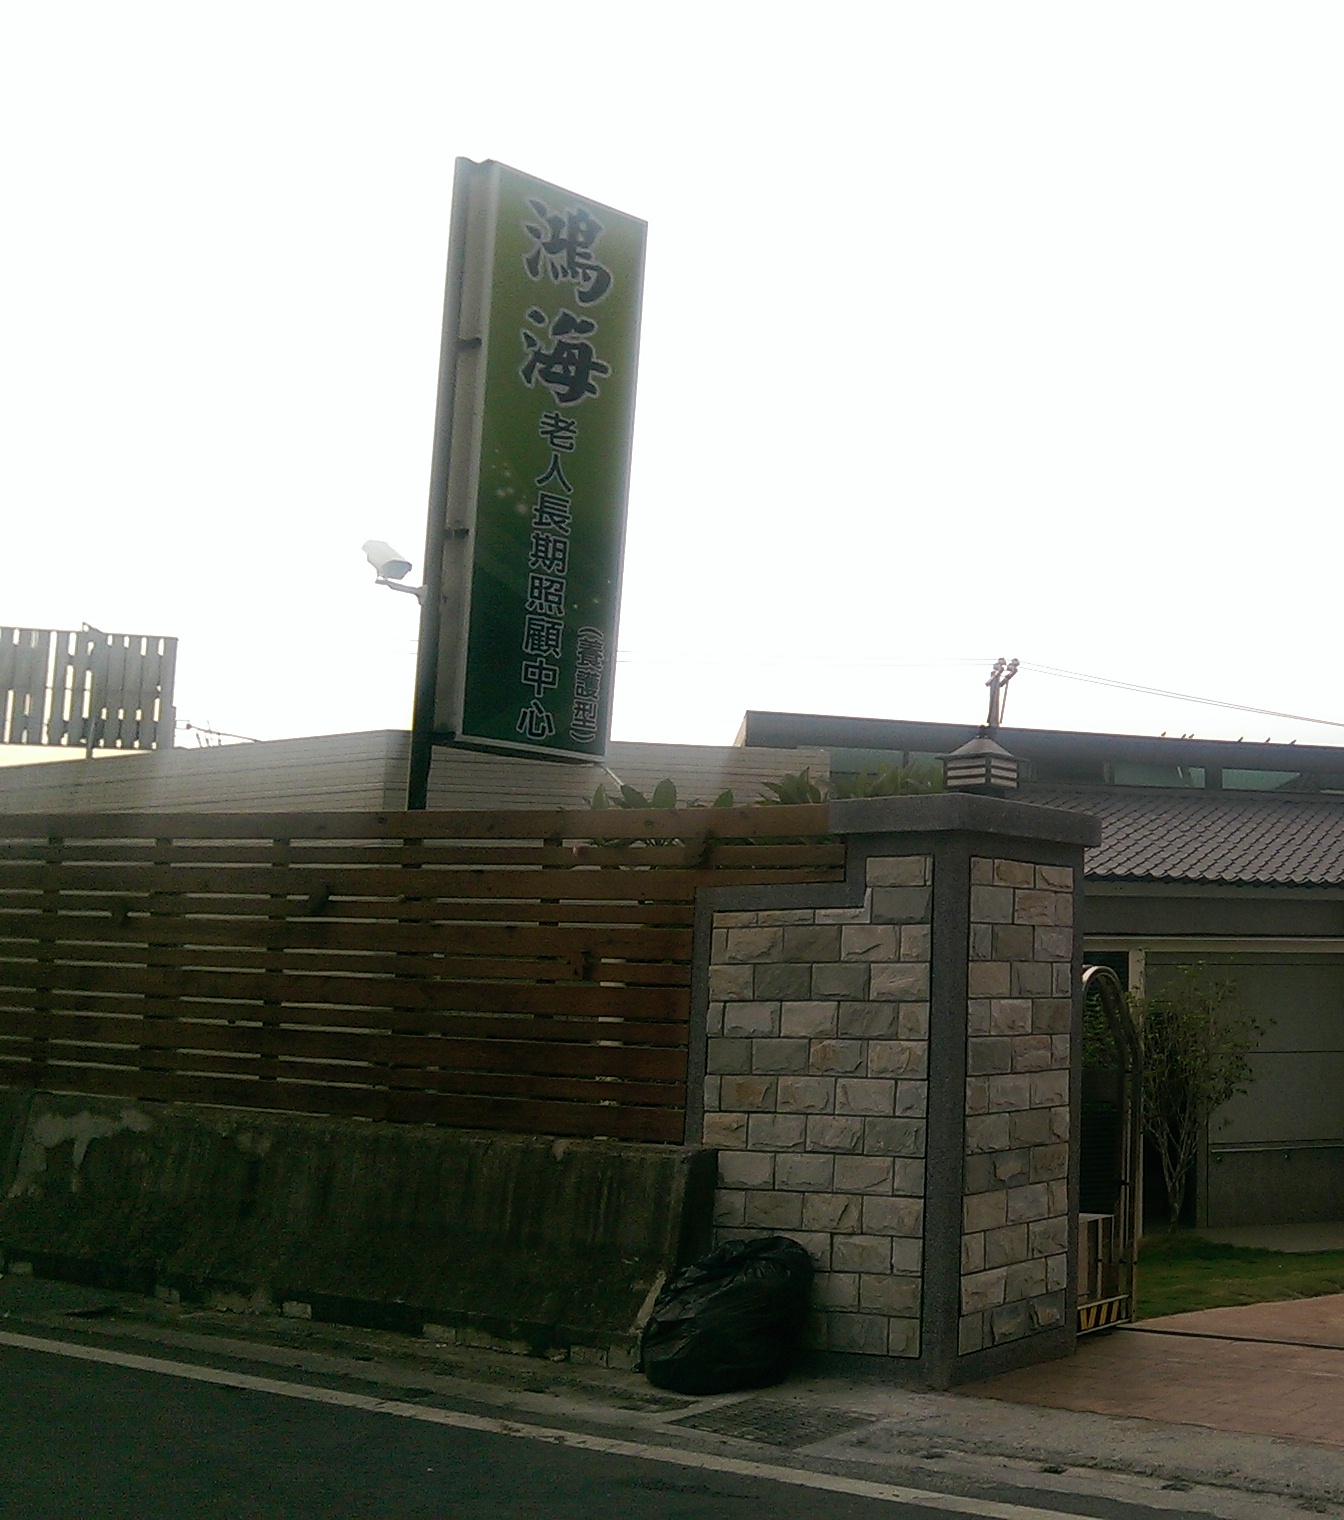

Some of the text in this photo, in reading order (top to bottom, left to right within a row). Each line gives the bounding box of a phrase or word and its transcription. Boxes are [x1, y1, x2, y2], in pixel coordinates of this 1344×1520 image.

[519, 198, 613, 406] 鴻海
[516, 411, 577, 740] 老人長期照顧中心
